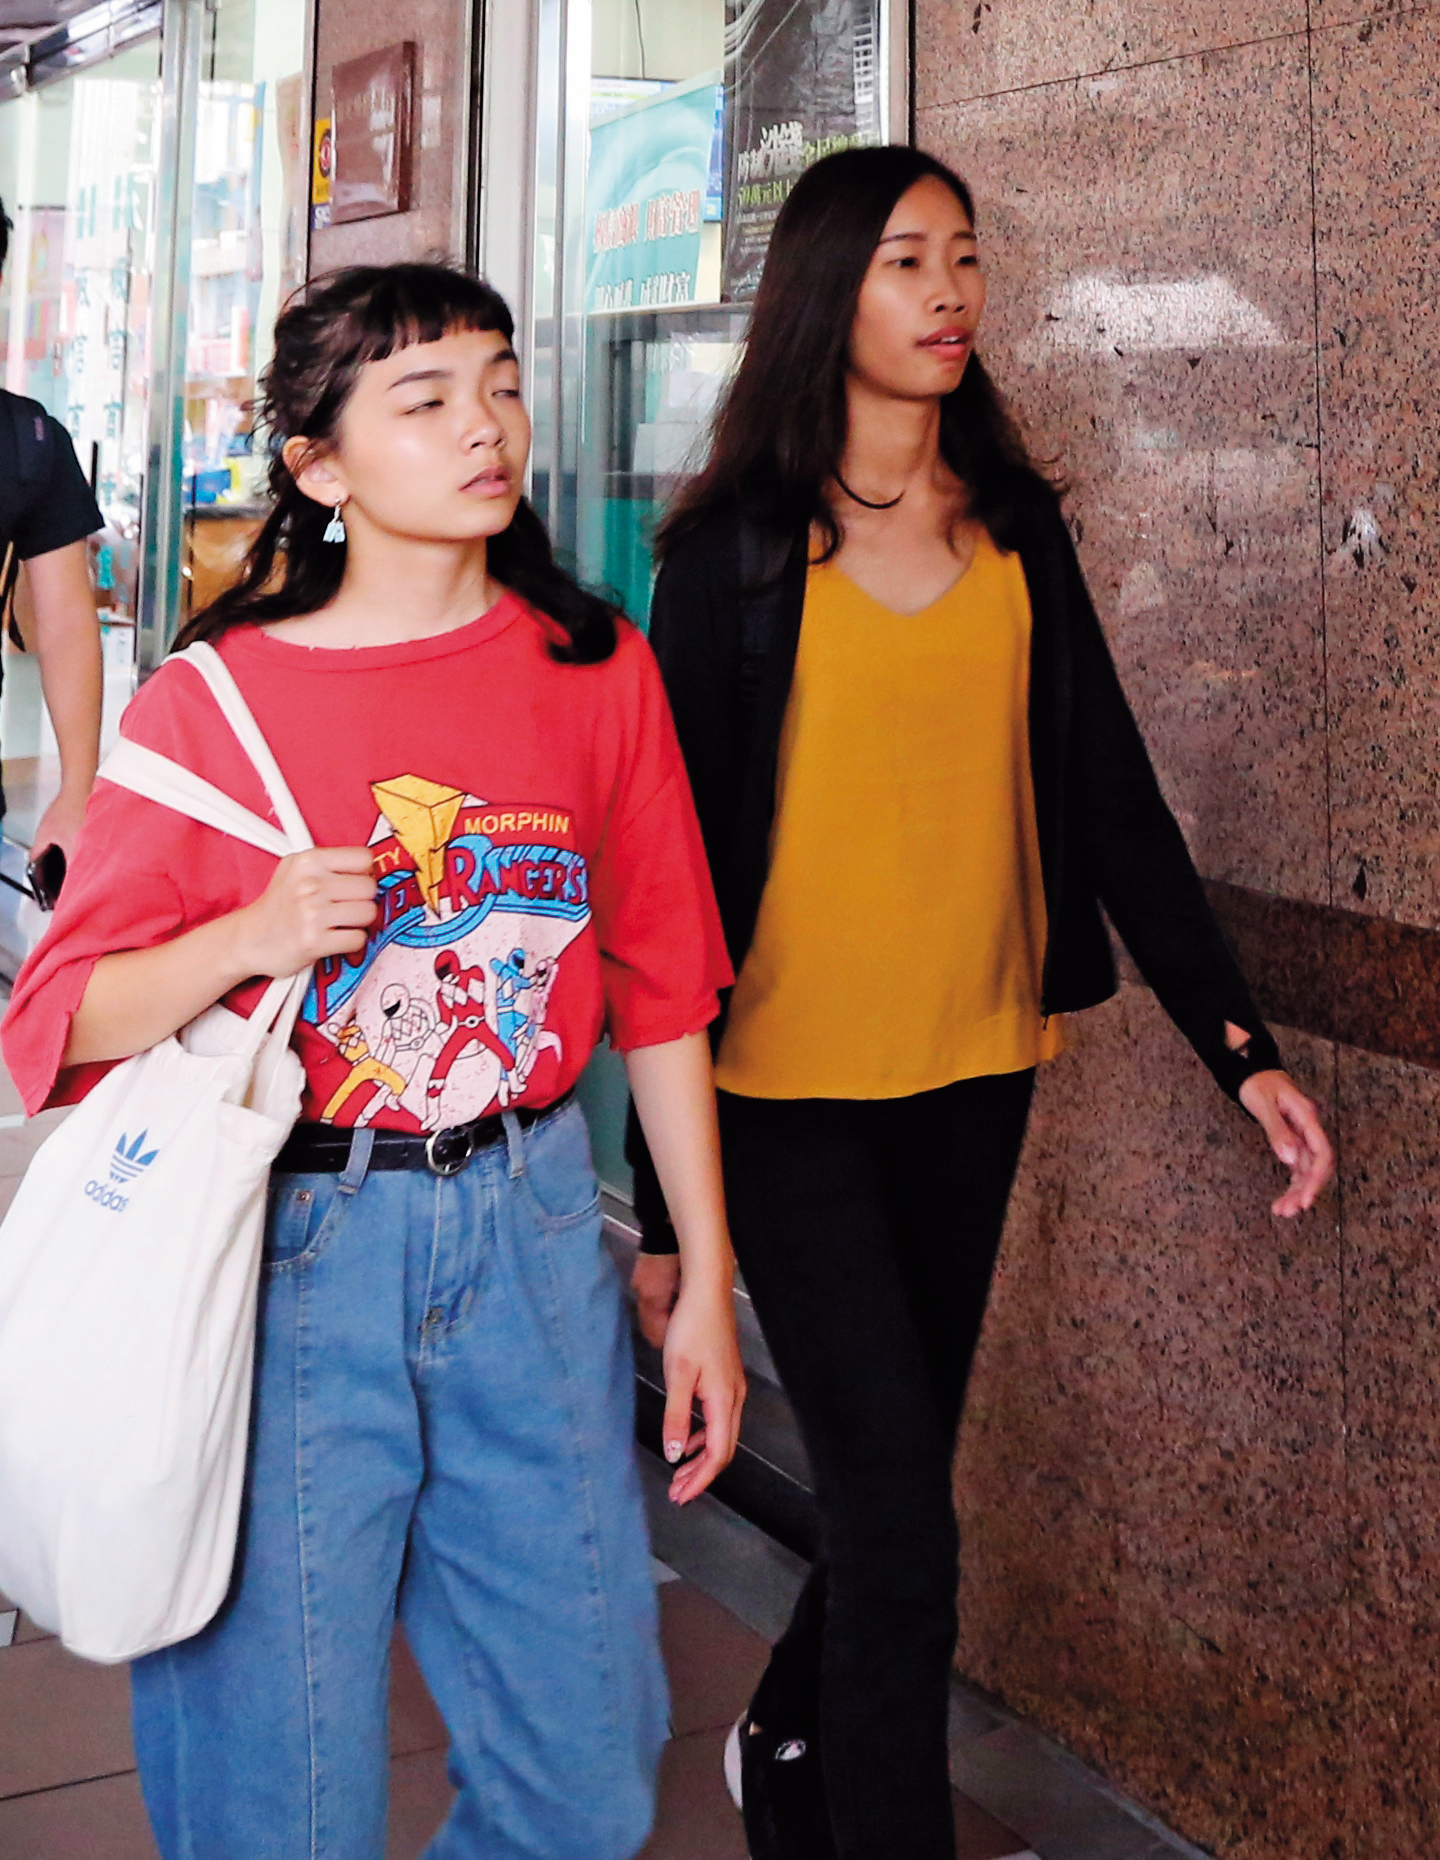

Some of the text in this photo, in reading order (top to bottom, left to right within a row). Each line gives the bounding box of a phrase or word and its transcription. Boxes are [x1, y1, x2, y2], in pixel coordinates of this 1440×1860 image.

[464, 811, 570, 836] MORPHIN
[445, 846, 585, 912] RANGERS
[84, 1180, 131, 1213] adidas
